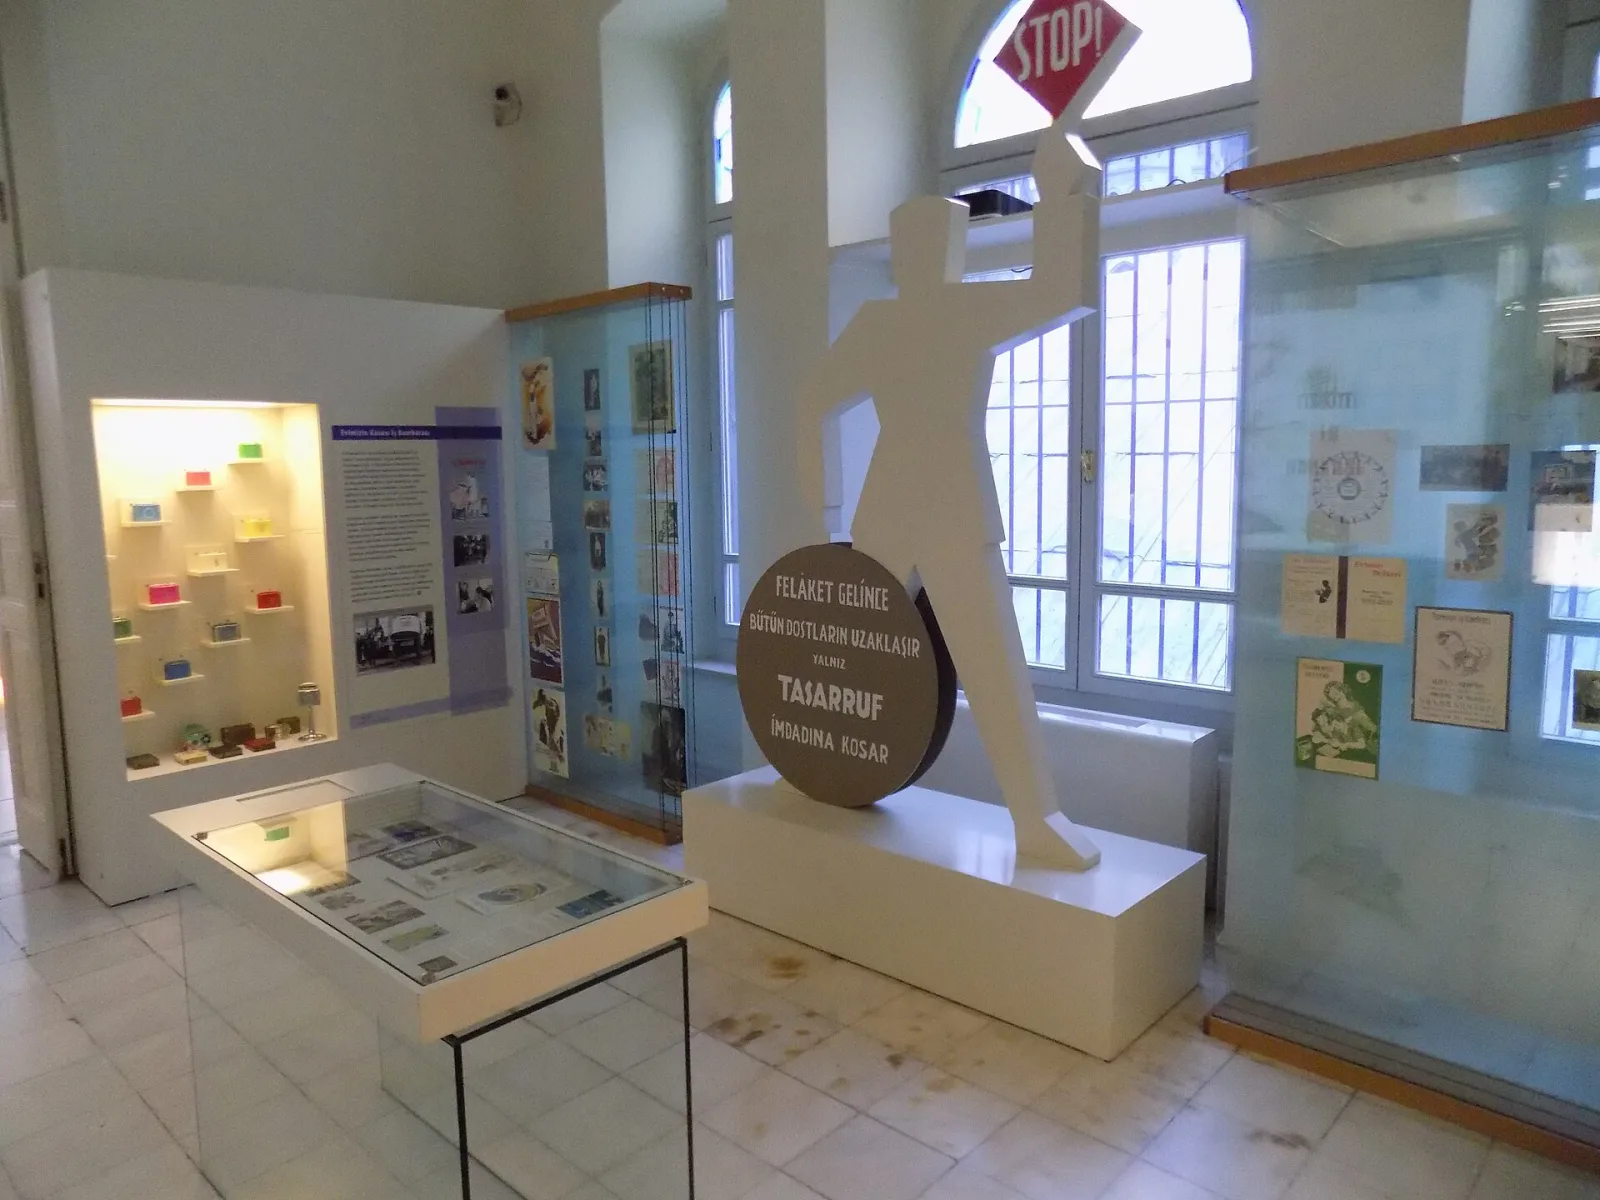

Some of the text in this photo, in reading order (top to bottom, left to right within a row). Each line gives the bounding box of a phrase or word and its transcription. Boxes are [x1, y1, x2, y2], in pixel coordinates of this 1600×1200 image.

[1014, 1, 1103, 82] STOP!
[786, 619, 848, 646] DOSTLARIN
[851, 628, 921, 659] UZAKLAŞIR
[812, 653, 846, 670] YALNIZ
[777, 674, 884, 721] TASARRUF
[841, 735, 889, 765] KOSAR
